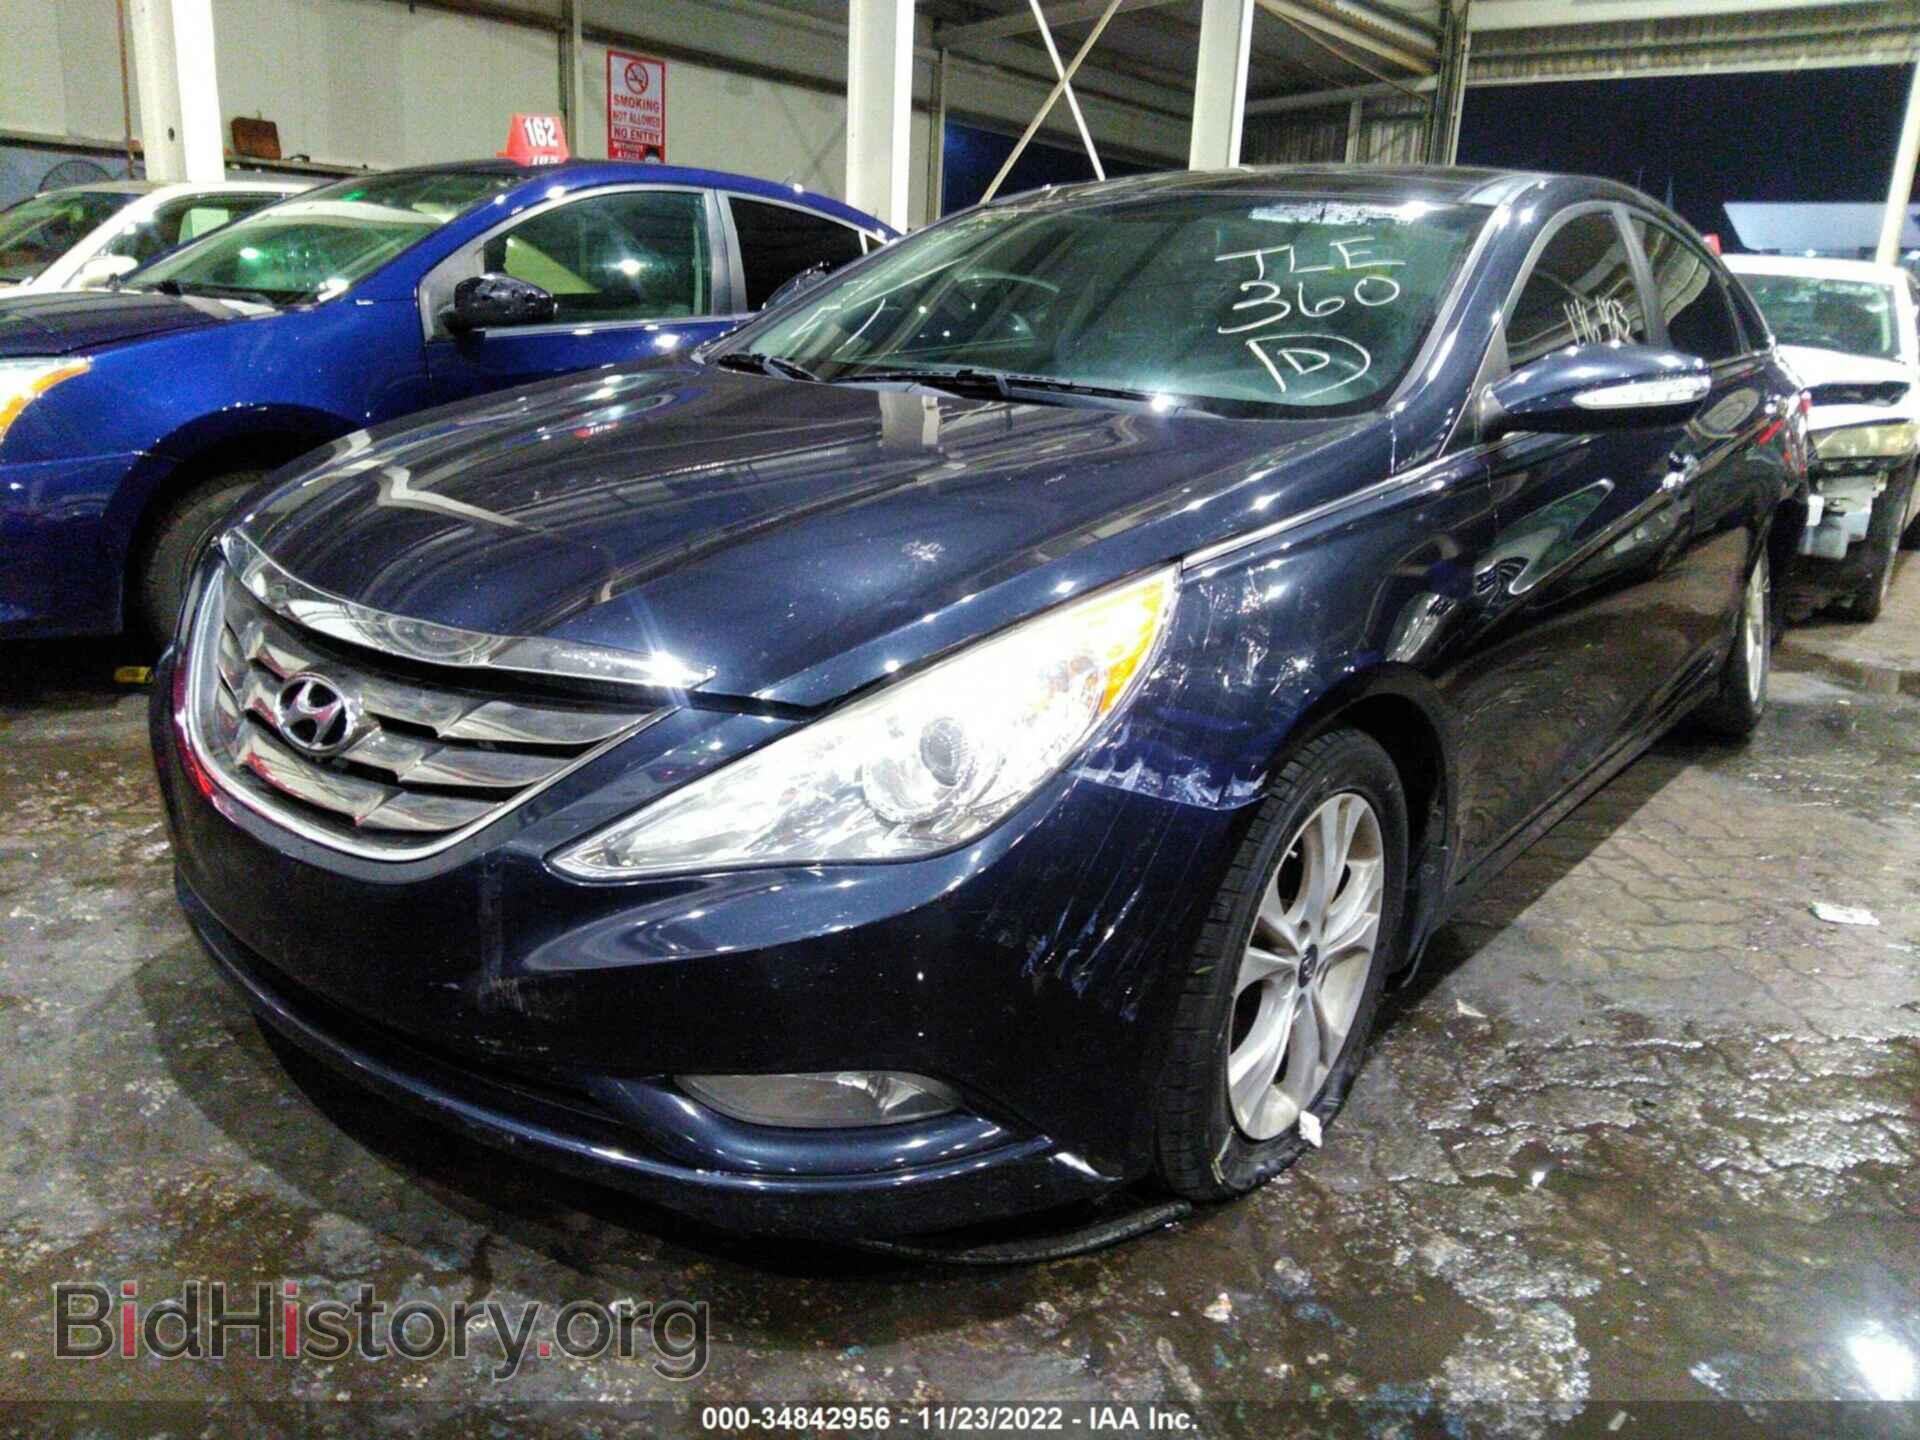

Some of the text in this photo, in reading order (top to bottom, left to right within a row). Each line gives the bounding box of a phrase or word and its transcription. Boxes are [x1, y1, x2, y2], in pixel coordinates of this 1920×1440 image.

[614, 94, 660, 112] SMOKING
[614, 127, 660, 145] NO ENTRY
[1217, 275, 1400, 334] 360
